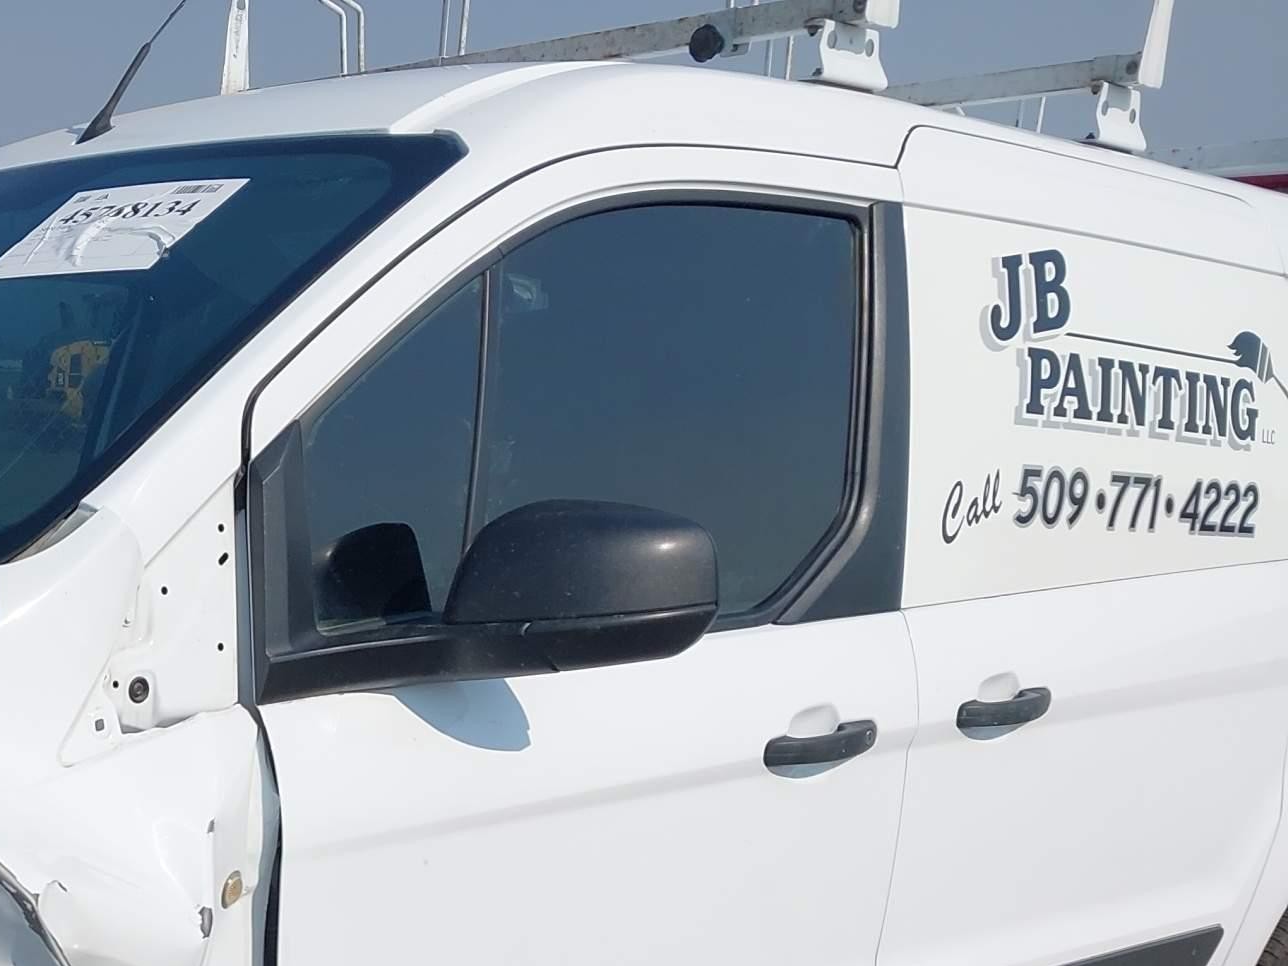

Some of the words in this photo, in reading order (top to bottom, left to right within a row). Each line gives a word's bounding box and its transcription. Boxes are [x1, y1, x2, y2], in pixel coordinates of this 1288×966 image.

[990, 249, 1072, 342] JB
[1024, 346, 1259, 442] PAINTING
[1262, 428, 1276, 446] LLC
[942, 469, 1003, 545] Call
